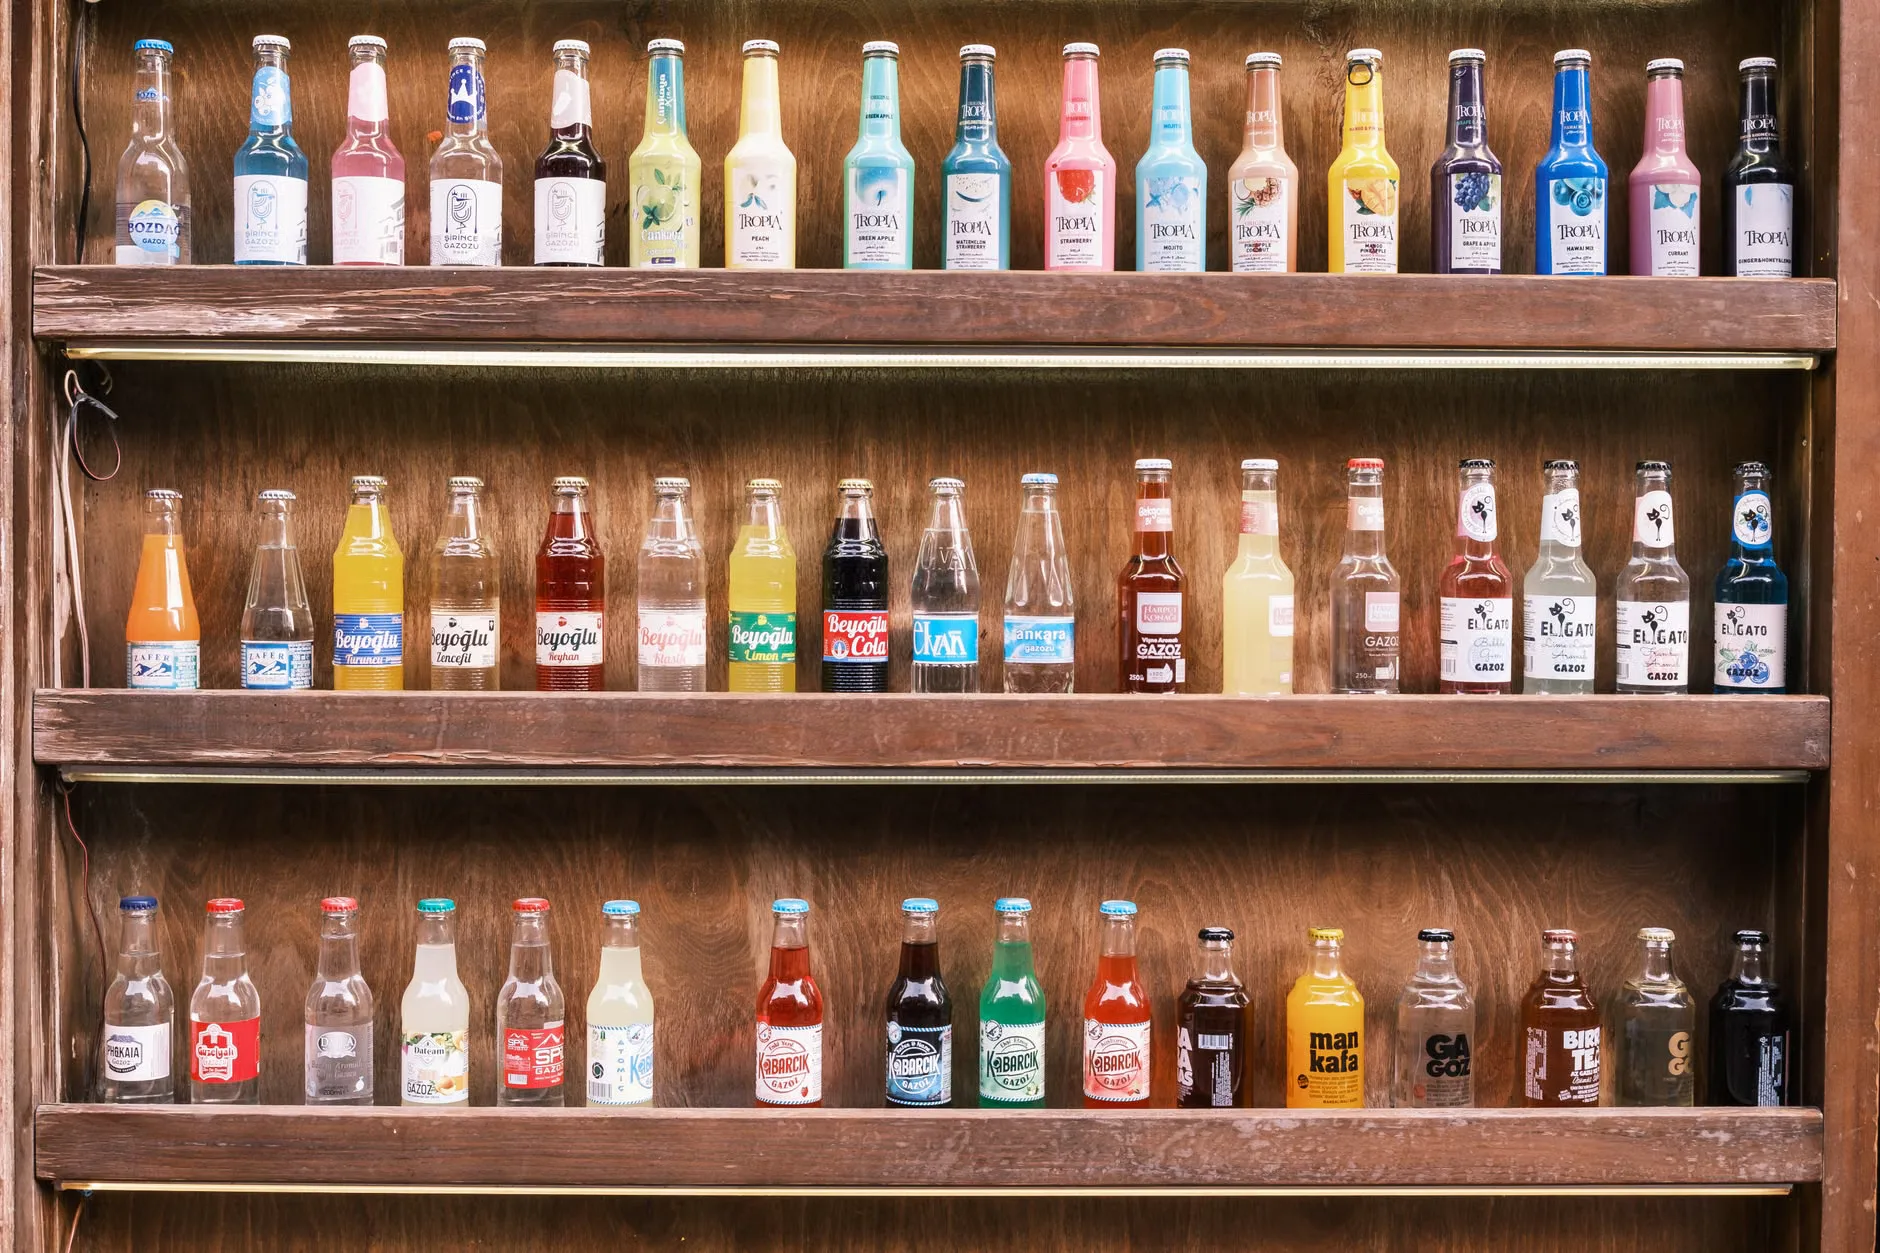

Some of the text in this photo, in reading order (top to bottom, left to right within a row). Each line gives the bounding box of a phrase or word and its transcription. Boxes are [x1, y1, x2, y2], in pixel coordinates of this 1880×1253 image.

[128, 221, 181, 236] BOZDAĞ
[739, 213, 783, 231] TROPIA
[854, 213, 899, 230] TROPIA
[952, 219, 992, 236] TROPIA
[1056, 216, 1096, 232] TROPIA
[1459, 218, 1498, 236] TROPIA
[444, 233, 479, 244] ŞİRİNCE
[752, 235, 770, 243] PEACH
[877, 235, 895, 243] APPLE
[1151, 223, 1195, 240] TROPIA
[1236, 224, 1281, 240] TROPIA
[1350, 224, 1394, 241] TROPIA
[1557, 224, 1601, 241] TROPIA
[1656, 229, 1696, 246] TROPIA
[1744, 230, 1789, 247] TROPIA
[142, 238, 167, 246] GAZOZ
[545, 239, 579, 248] GAZOZU
[1463, 240, 1478, 248] GRAPE
[828, 613, 888, 639] Beyoğlu
[1737, 624, 1767, 636] GATO
[335, 629, 399, 654] Beyoğlu
[431, 627, 490, 652] Beyoğlu
[538, 626, 598, 652] Beyoğlu
[641, 627, 703, 652] Beyoğlu
[732, 625, 794, 651] Beyoğlu
[1016, 628, 1066, 643] ankara
[850, 635, 886, 656] Cola
[1024, 644, 1055, 655] gazozu
[1137, 644, 1182, 656] GAZOZ
[134, 652, 170, 663] ZAFER
[249, 652, 285, 662] ZAFER
[436, 651, 472, 666] Zencefil
[548, 651, 580, 664] Reyhan
[744, 649, 779, 661] Limon
[1474, 662, 1505, 672] GAZOZ
[1553, 664, 1586, 672] GAZOZ
[1726, 668, 1761, 677] GAZOZ
[1646, 672, 1679, 681] GAZOZ
[1309, 1031, 1359, 1051] man
[1426, 1034, 1470, 1060] GA
[758, 1051, 810, 1079] KABARCIK
[888, 1052, 941, 1079] KABARCIK
[986, 1049, 1040, 1077] KABARCIK
[1088, 1049, 1141, 1077] KABARCIK
[1309, 1049, 1359, 1074] kafa
[407, 1081, 433, 1096] GAZOZ
[771, 1077, 799, 1090] GAZOZ
[902, 1078, 931, 1091] GAZOZ
[1002, 1075, 1031, 1088] GAZOZ
[1103, 1075, 1132, 1088] GAZOZ
